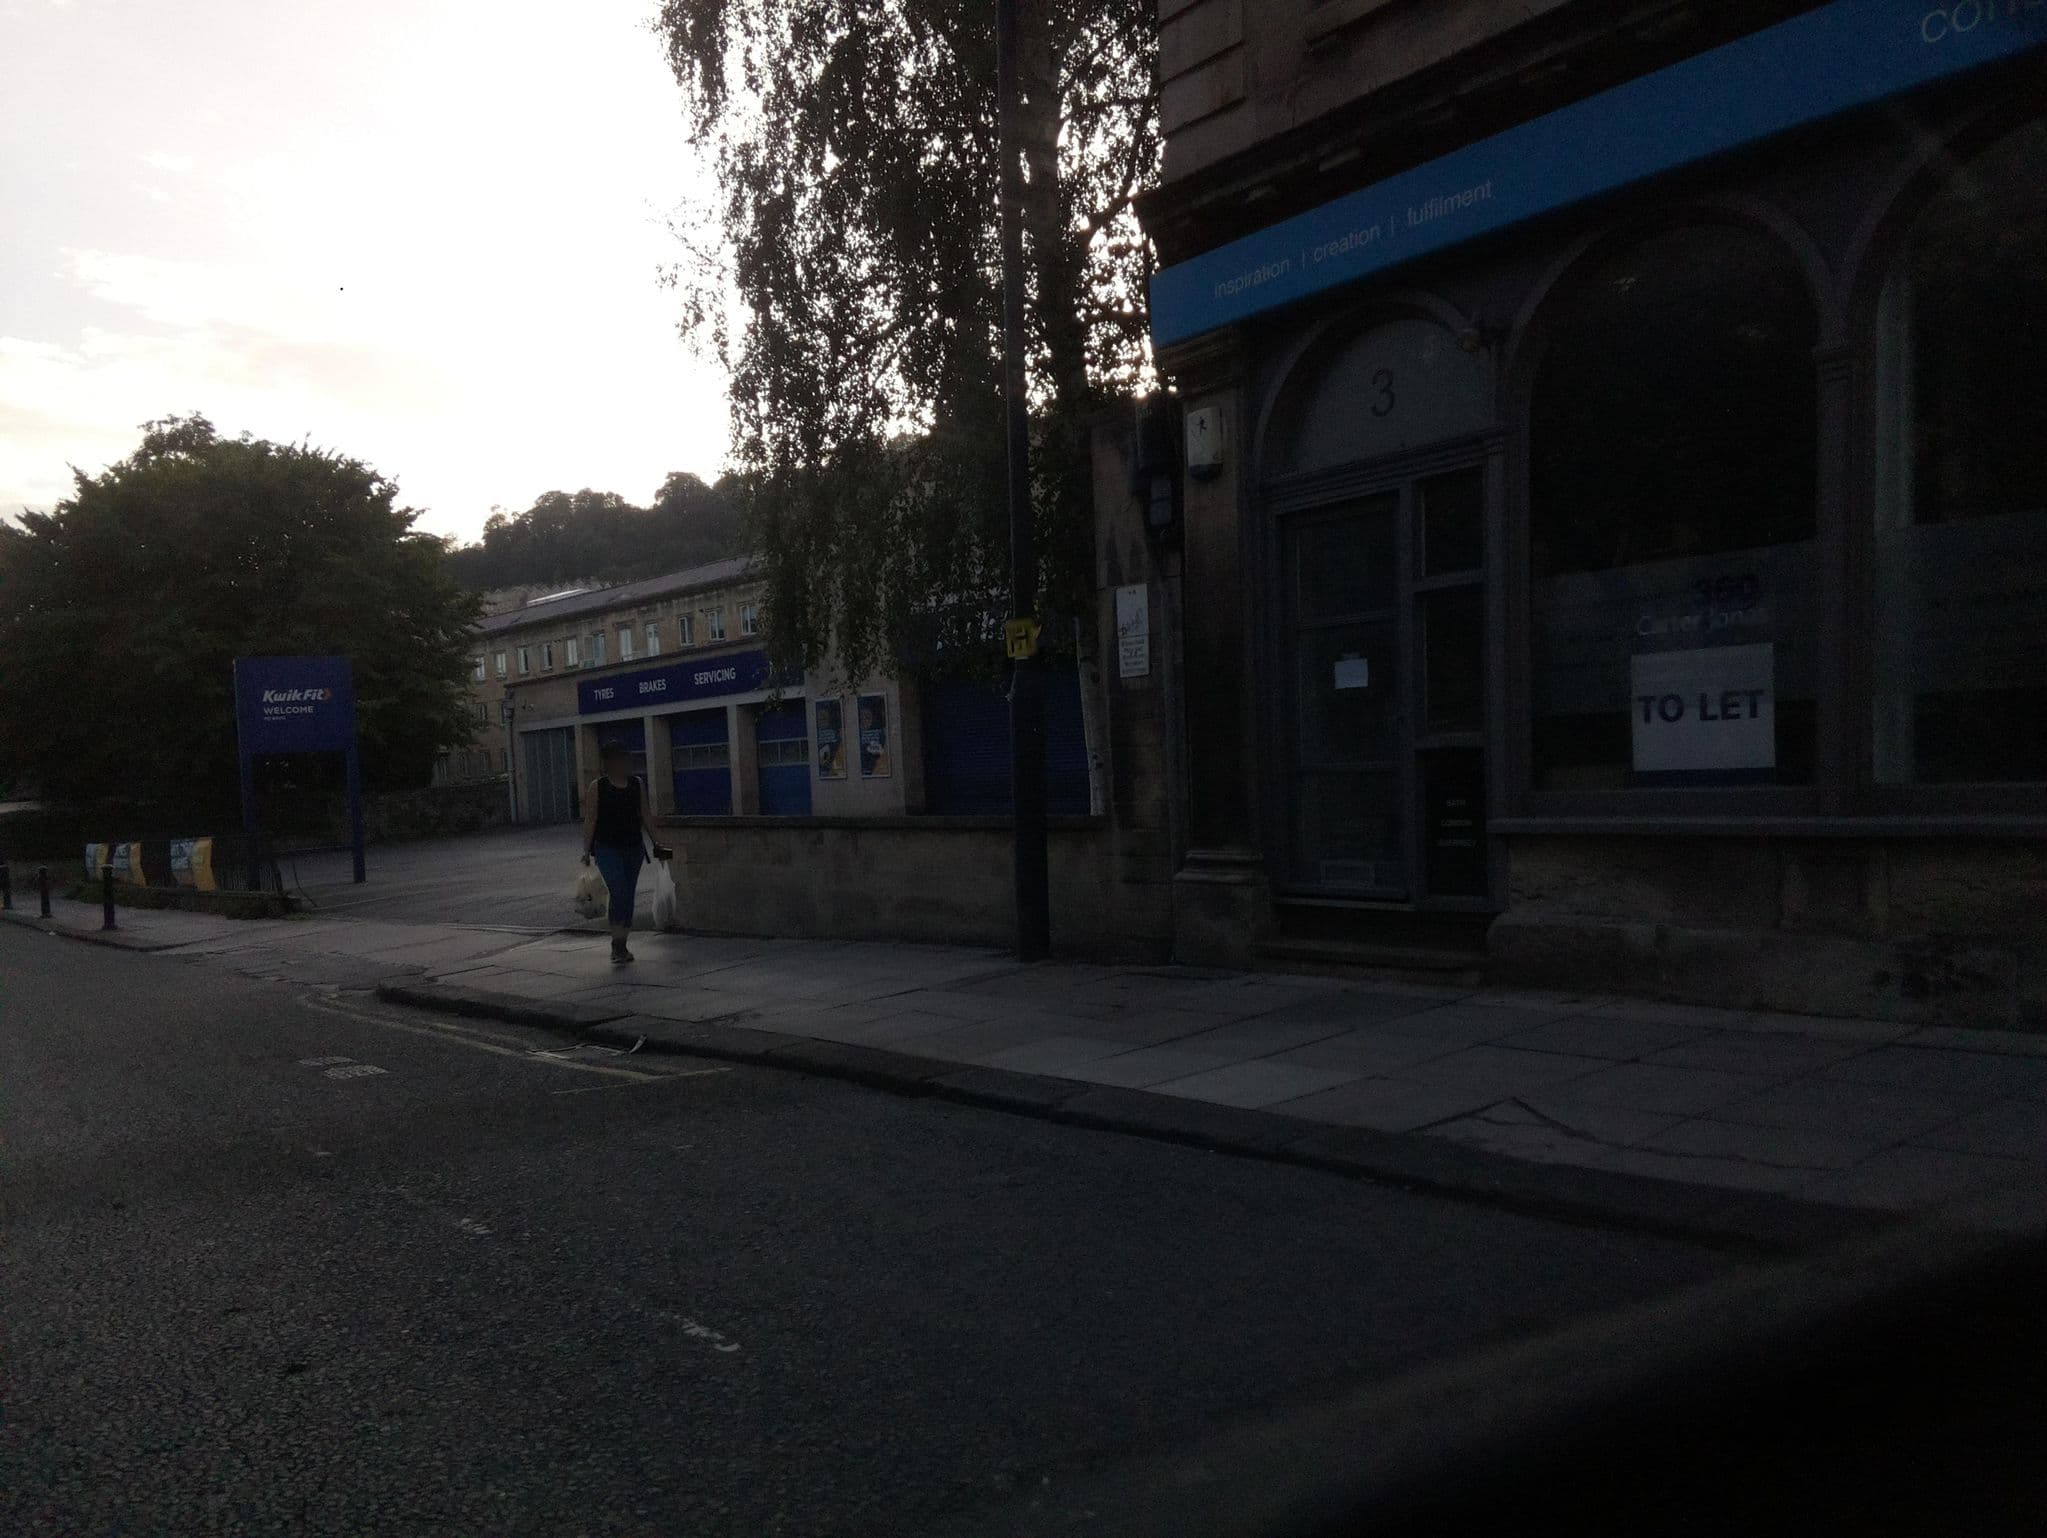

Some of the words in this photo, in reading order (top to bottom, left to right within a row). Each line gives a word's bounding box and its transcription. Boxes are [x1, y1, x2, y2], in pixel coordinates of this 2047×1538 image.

[1213, 259, 1290, 299] inspiration
[1313, 223, 1381, 264] creation
[1406, 179, 1492, 226] fulfilment
[1371, 368, 1395, 417] 3
[594, 687, 614, 701] TYRES
[639, 678, 666, 694] BRAKES
[694, 667, 736, 686] SERVICING
[263, 705, 314, 715] WELCOME
[1638, 694, 1684, 723] TO
[1699, 689, 1763, 721] LET
